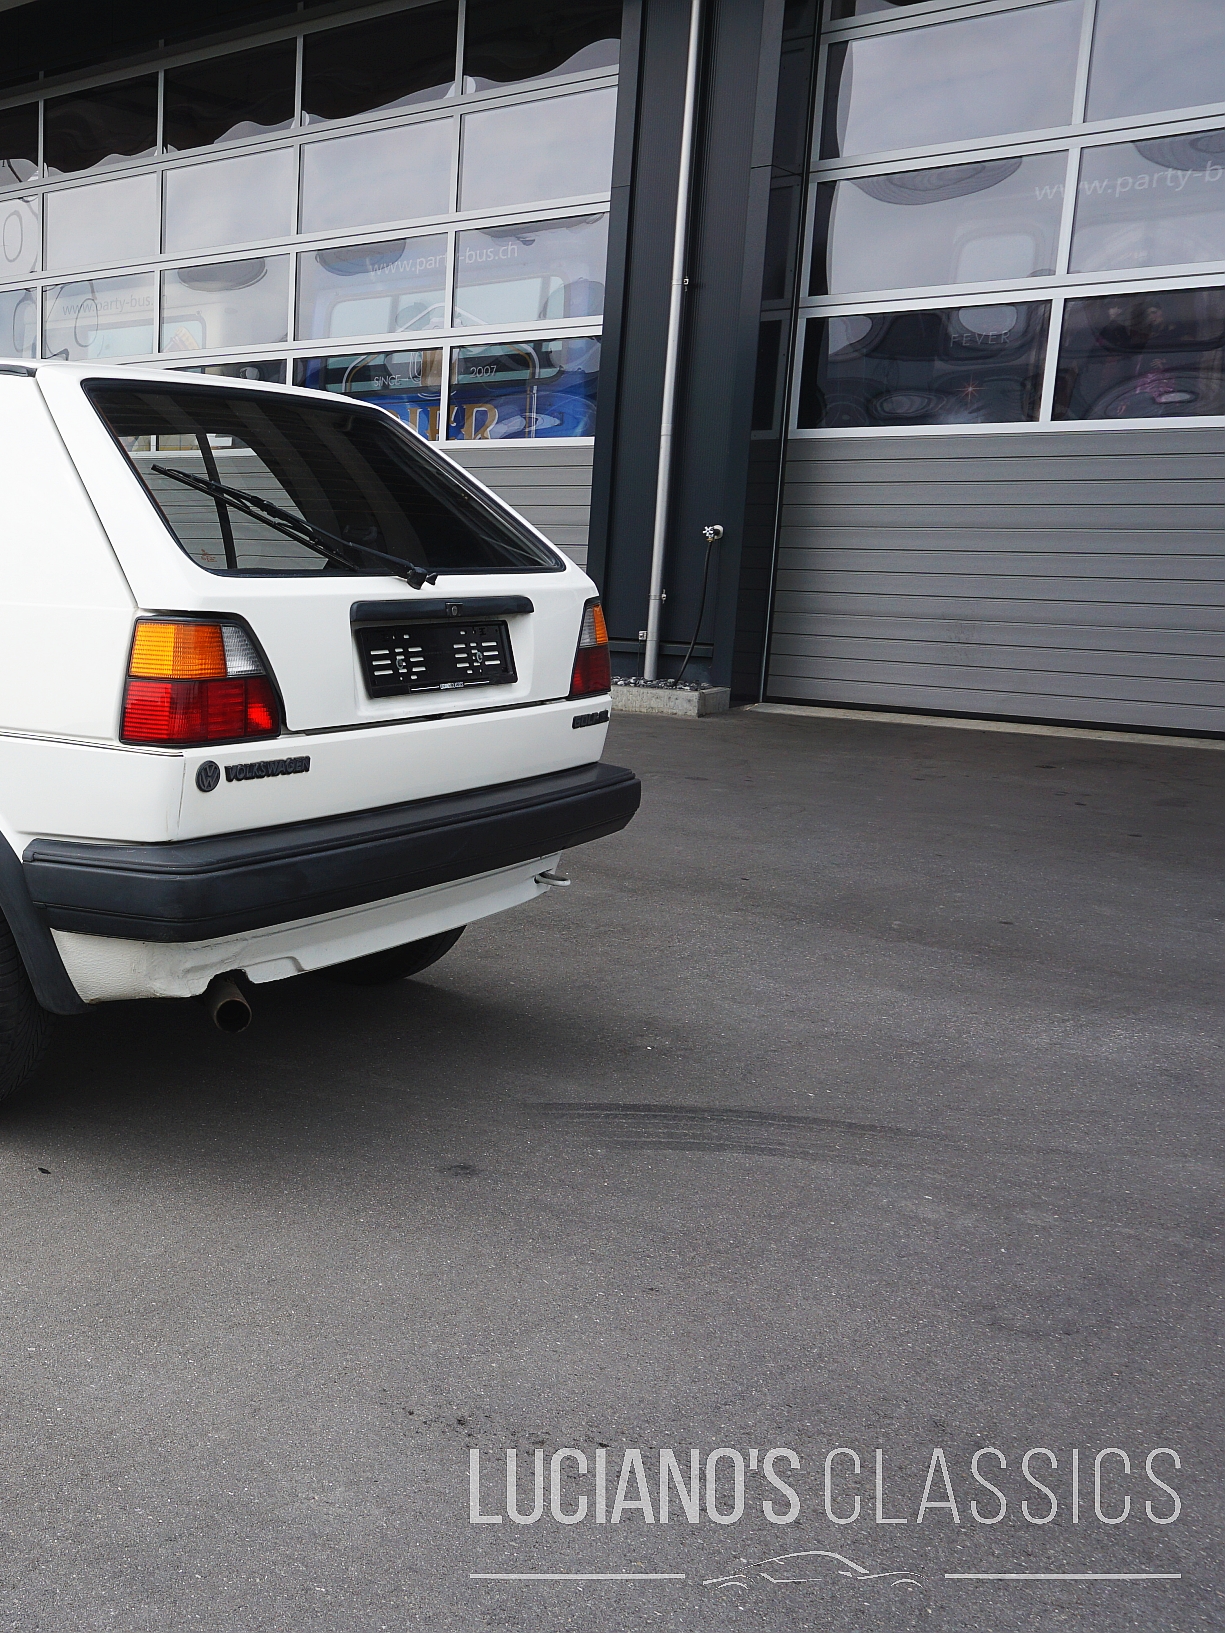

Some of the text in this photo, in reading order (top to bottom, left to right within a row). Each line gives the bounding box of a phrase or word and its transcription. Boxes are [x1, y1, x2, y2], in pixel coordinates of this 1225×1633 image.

[369, 241, 518, 276] www.part-bus.ch
[950, 330, 1010, 347] FEVER
[374, 365, 497, 387] SINCE 2007
[224, 755, 311, 783] VOLKSWAGEN
